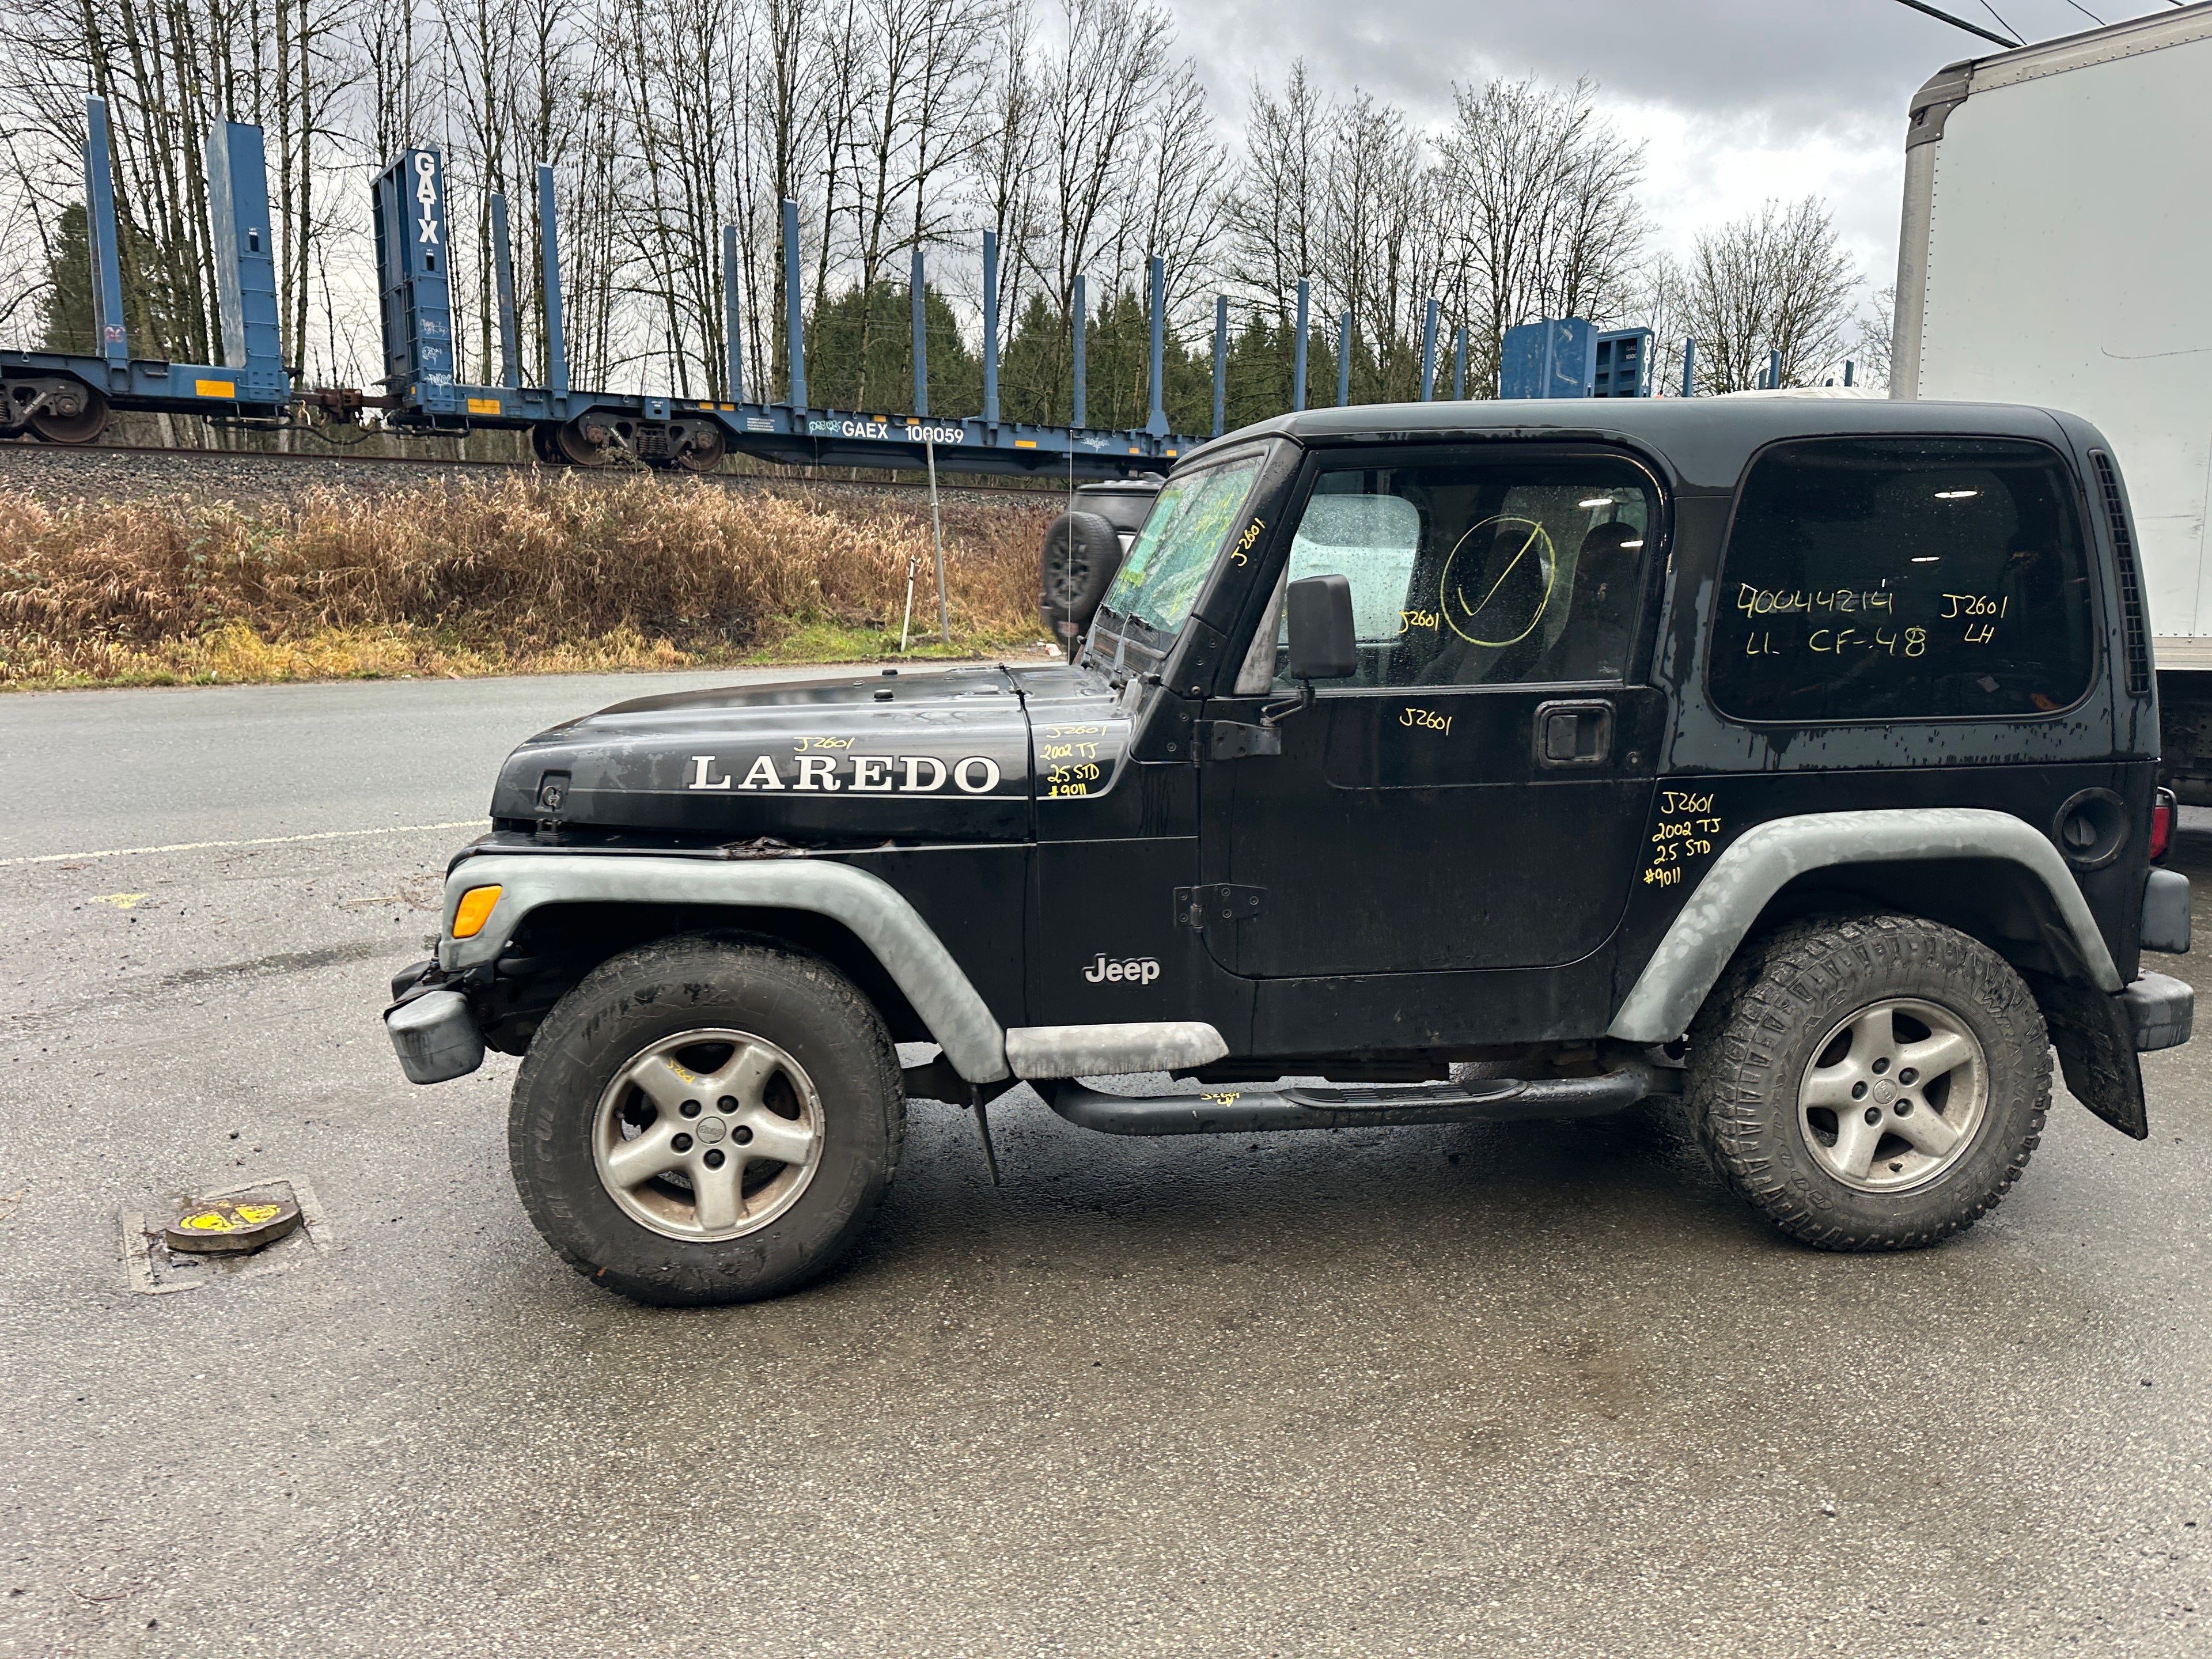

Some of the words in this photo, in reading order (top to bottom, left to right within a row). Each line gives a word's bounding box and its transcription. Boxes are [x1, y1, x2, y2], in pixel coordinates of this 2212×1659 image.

[415, 152, 439, 244] GATX
[1641, 334, 1653, 387] GATX
[842, 421, 889, 439] GAEX
[905, 426, 964, 444] 100059
[1230, 517, 1266, 567] J2601
[1941, 594, 2008, 618] J2601
[1397, 611, 1440, 634] J2601
[1964, 623, 1994, 643] LH
[1046, 726, 1108, 738] J2601
[1399, 708, 1452, 736] J2601
[793, 736, 855, 752] J2601
[1040, 744, 1073, 760] 2002
[1075, 742, 1100, 759] TJ
[688, 755, 1001, 793] LAREDO
[1073, 763, 1100, 780] STD
[1661, 791, 1714, 814] J2601
[1652, 821, 1692, 842] 2002
[1696, 818, 1721, 833] TJ
[1685, 839, 1711, 857] STD
[1643, 866, 1681, 888] #9011
[1085, 957, 1160, 985] Jeep
